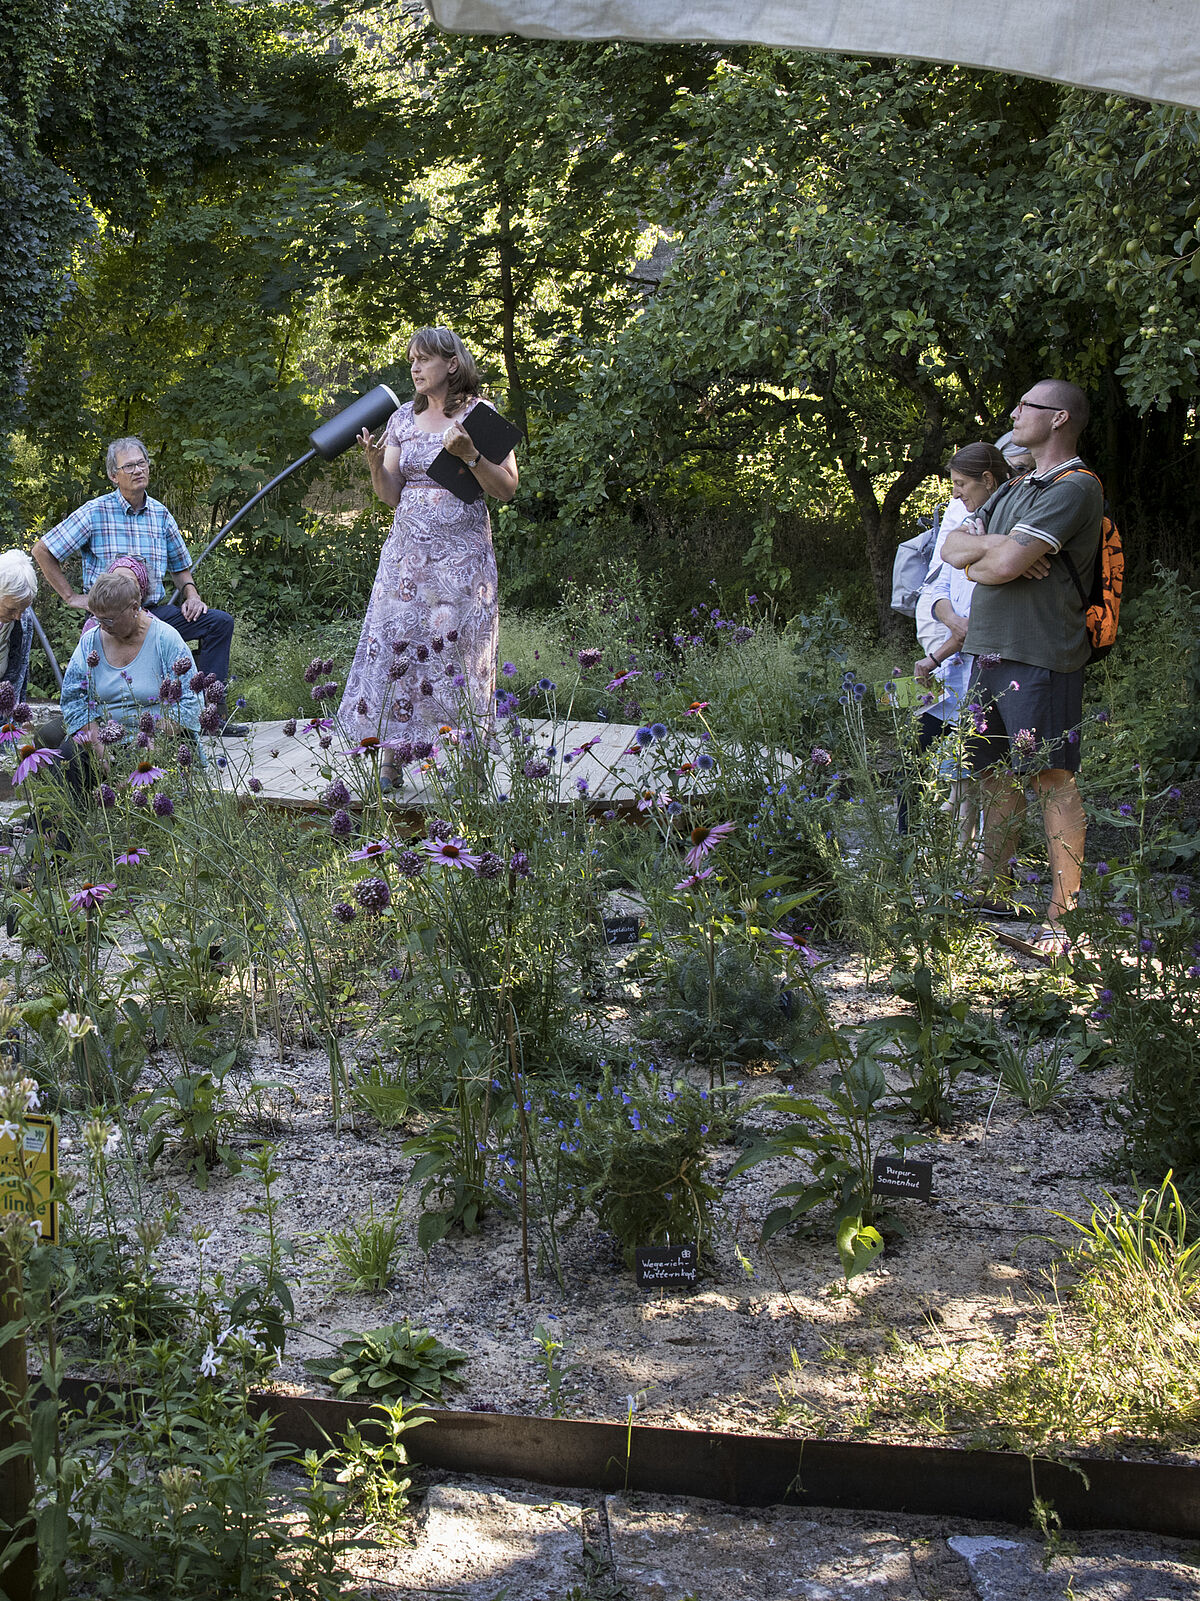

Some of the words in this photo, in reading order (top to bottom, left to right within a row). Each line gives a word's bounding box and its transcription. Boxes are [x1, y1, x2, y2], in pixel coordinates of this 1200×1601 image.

[0, 1170, 20, 1188] fü
[886, 1166, 917, 1179] Purpur-
[877, 1175, 920, 1188] Sonnenhut
